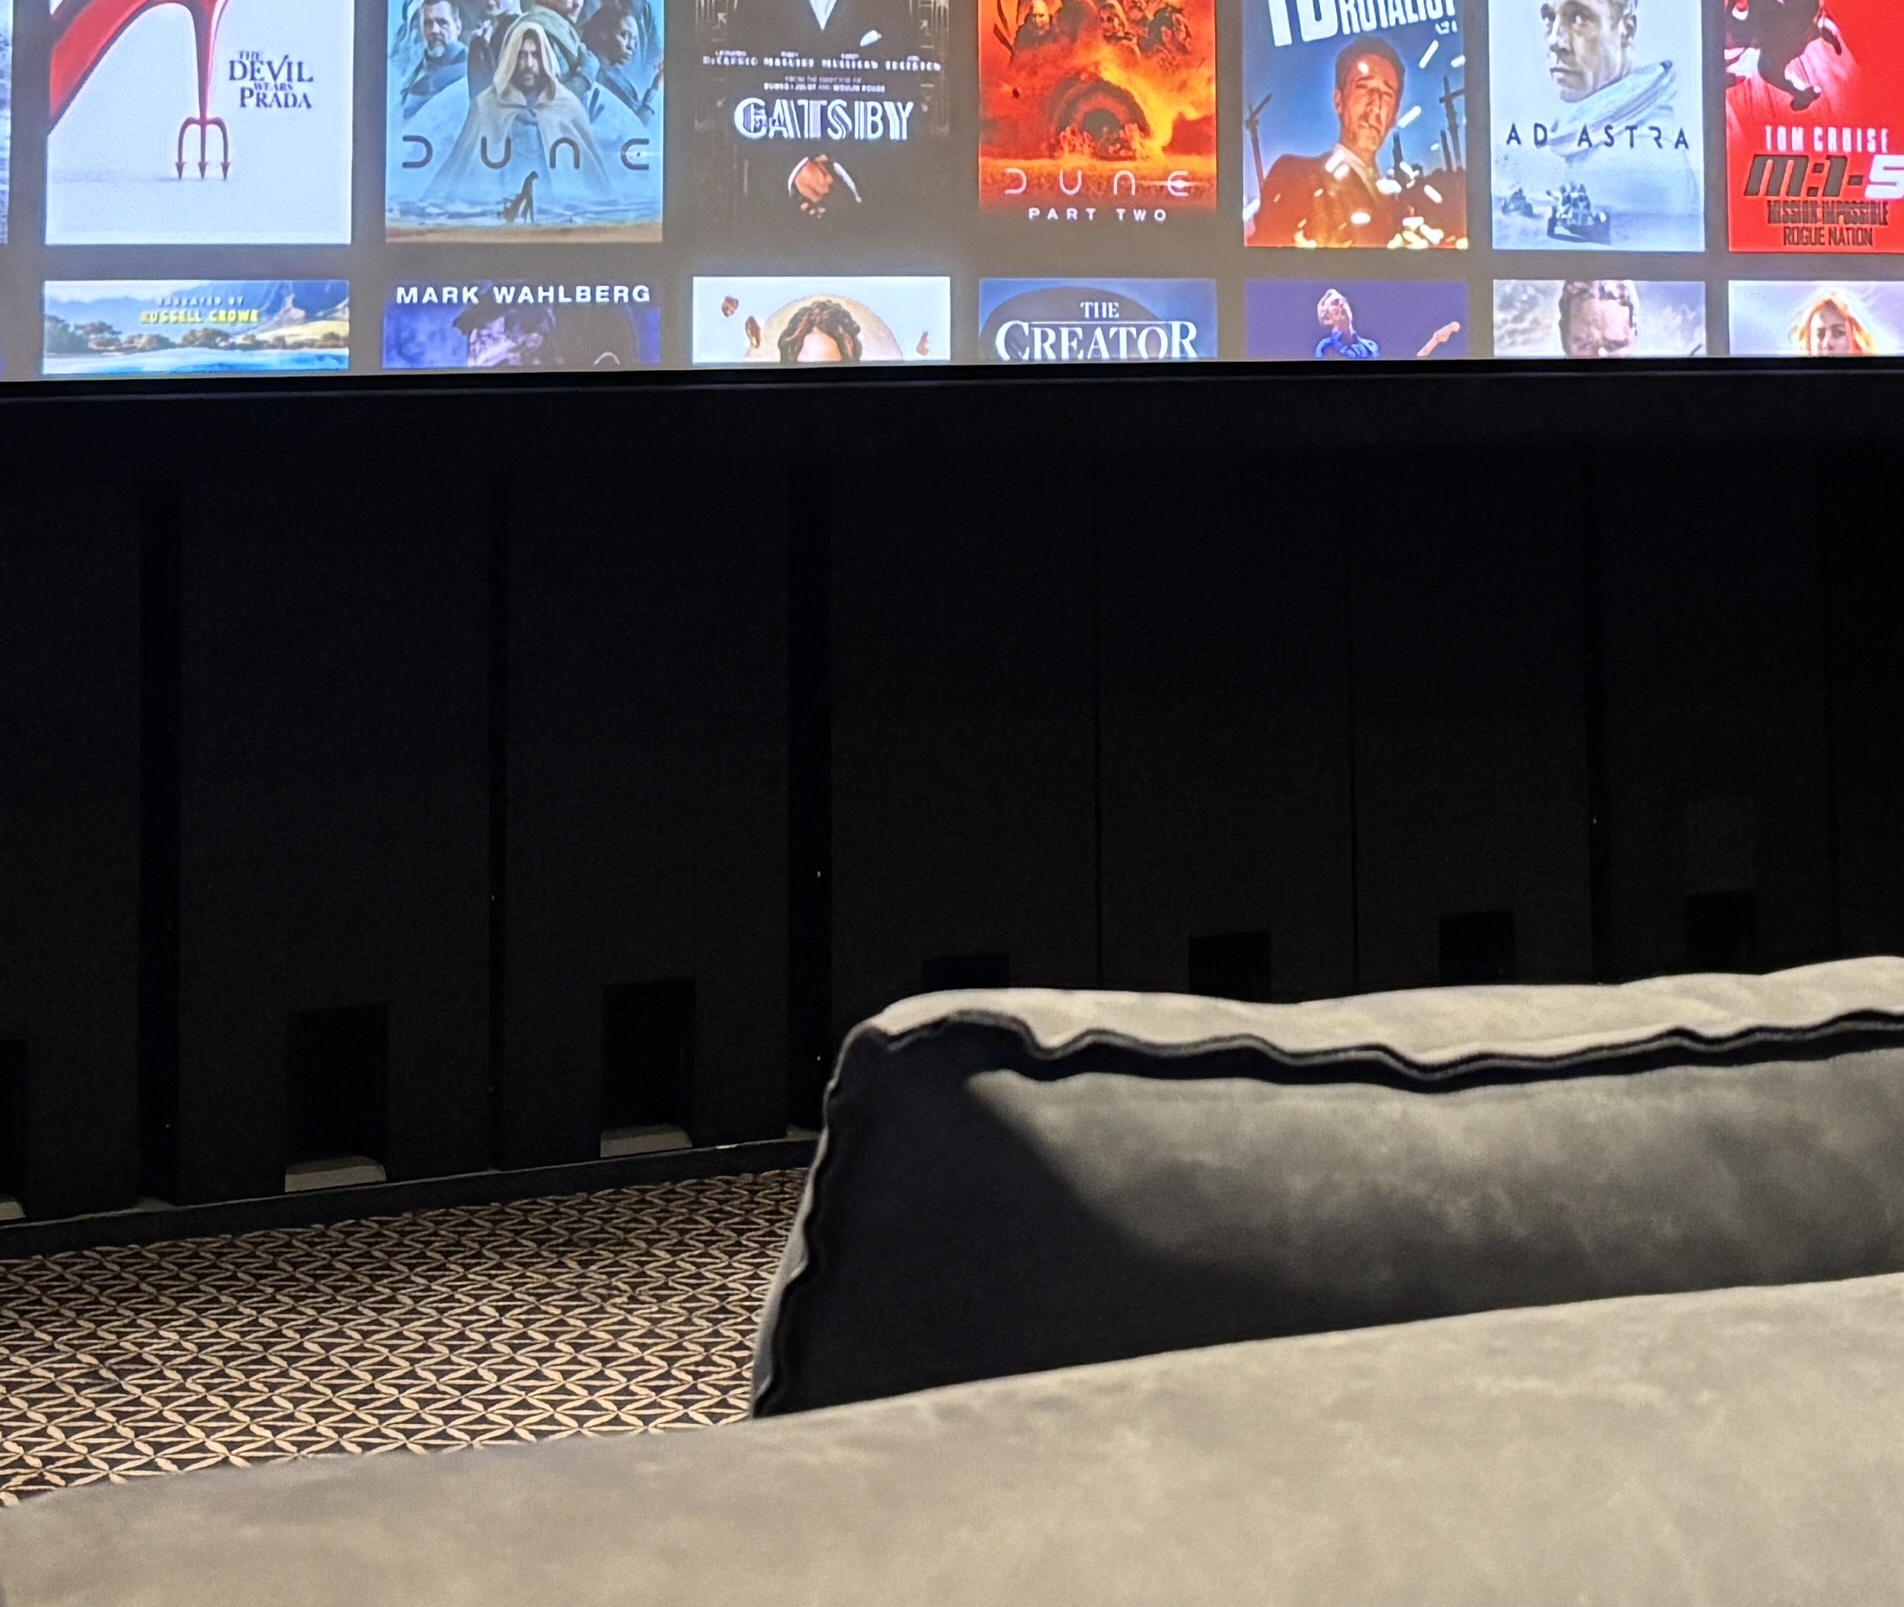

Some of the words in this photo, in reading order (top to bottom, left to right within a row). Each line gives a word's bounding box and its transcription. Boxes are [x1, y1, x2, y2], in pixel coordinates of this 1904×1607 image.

[229, 54, 314, 82] DEVIL
[240, 87, 312, 109] PRADA
[734, 98, 914, 140] GATSBY
[1506, 123, 1548, 148] AD
[1577, 124, 1689, 149] ASTRA
[1765, 125, 1804, 152] TOM
[1813, 126, 1888, 153] CRUISE
[402, 135, 649, 170] DUNE
[1004, 168, 1189, 197] DUNE
[1028, 207, 1096, 221] PART
[1116, 208, 1166, 222] TWO
[1784, 226, 1825, 245] ROGUE
[1828, 227, 1873, 246] NATION
[396, 286, 479, 304] MARK
[493, 285, 650, 304] WAHLBERG
[140, 309, 203, 324] RUSSELL
[209, 309, 259, 324] CROWE
[1080, 302, 1120, 319] THE
[996, 320, 1198, 361] CREATOR
